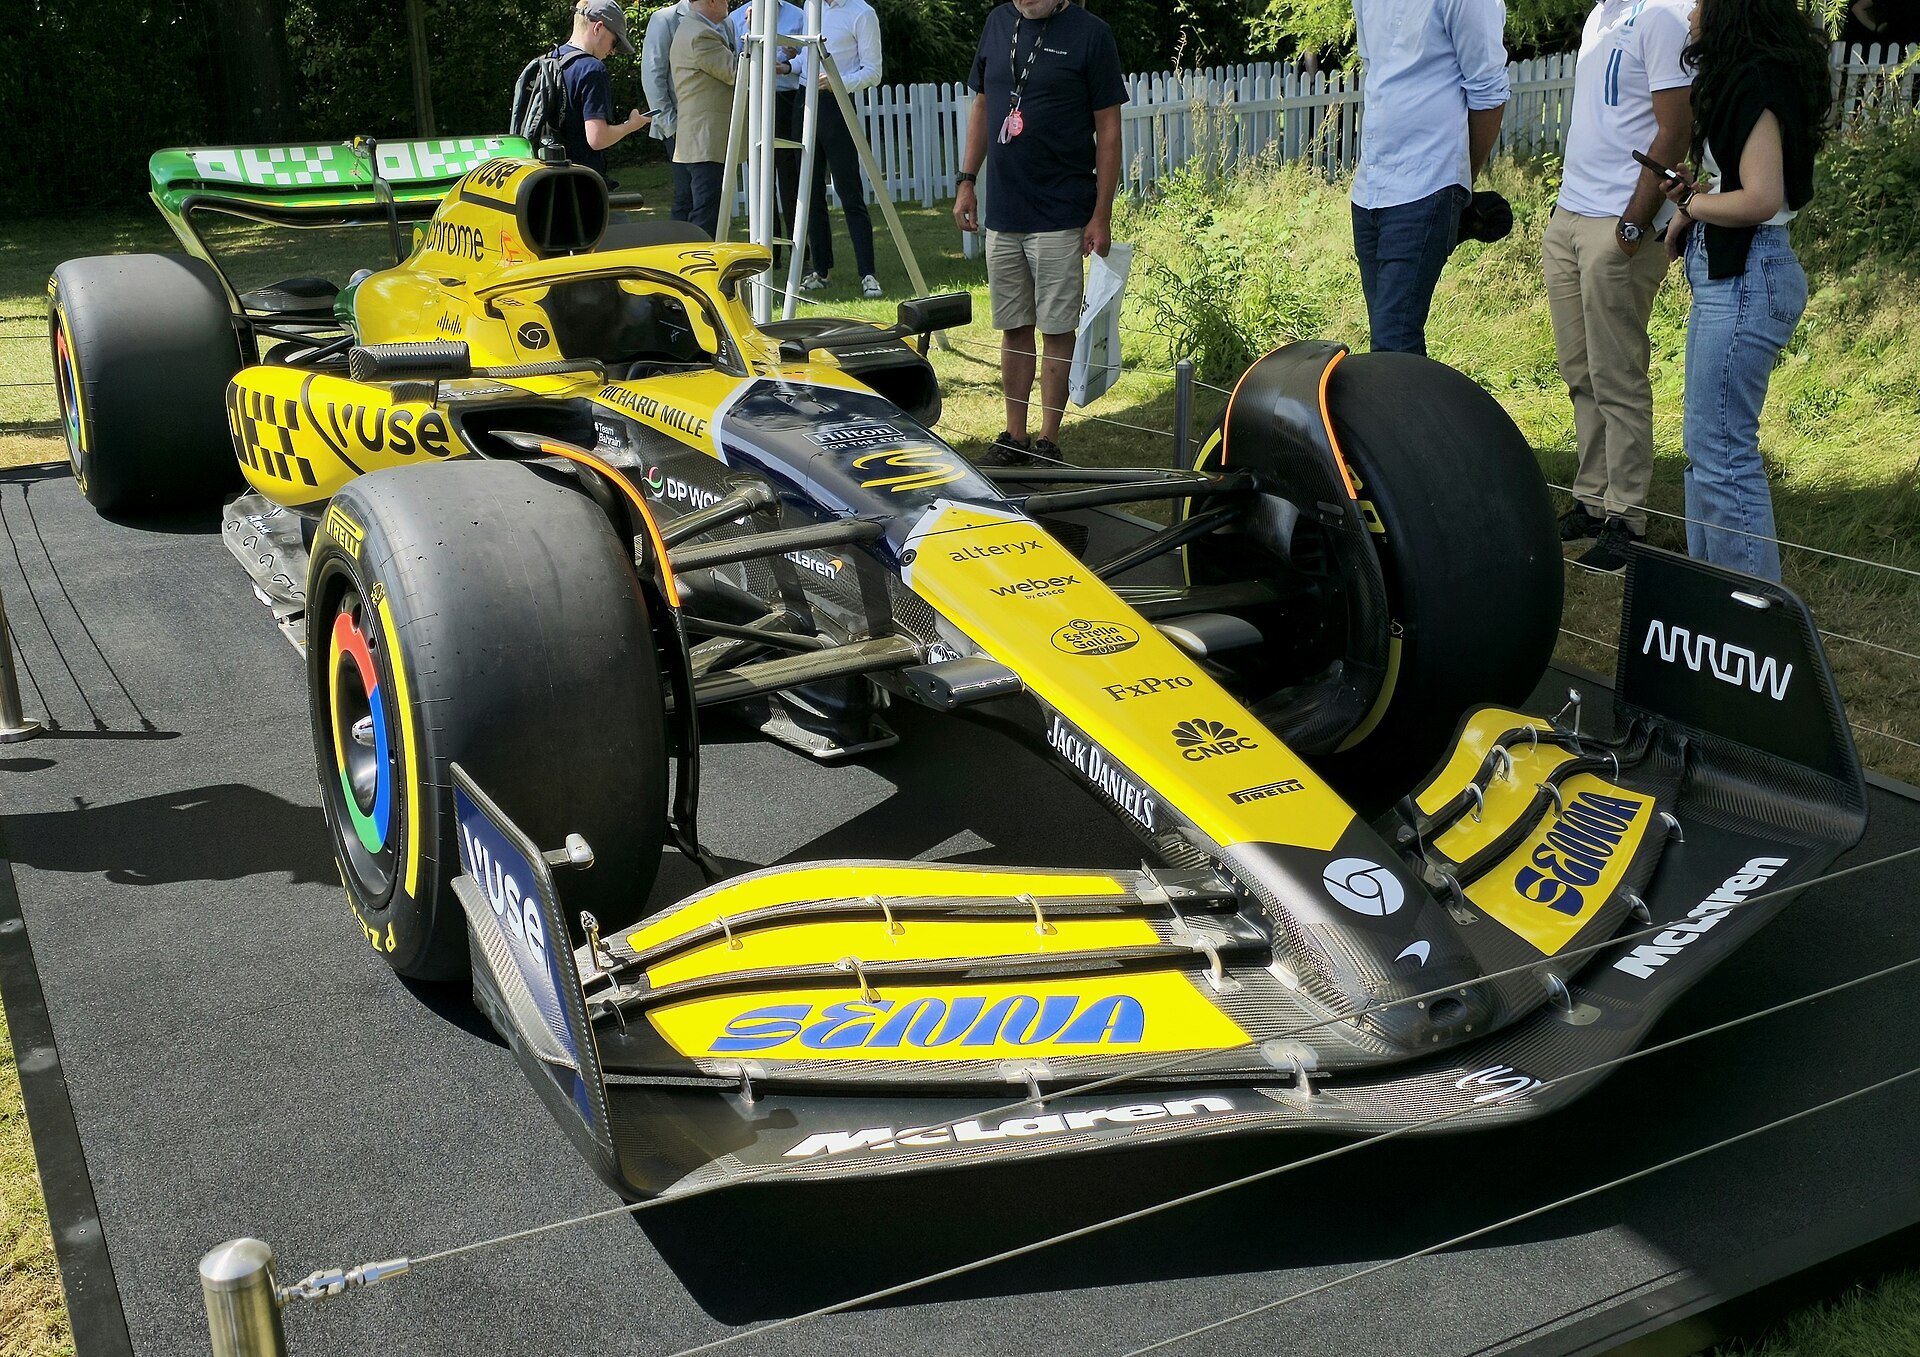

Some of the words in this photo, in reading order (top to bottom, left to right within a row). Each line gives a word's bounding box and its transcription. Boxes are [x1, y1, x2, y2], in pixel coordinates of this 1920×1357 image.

[426, 207, 484, 262] chrome
[598, 385, 659, 419] RICHARD
[660, 405, 707, 439] MILLE
[599, 422, 614, 436] Team
[599, 432, 621, 448] Bahrain
[813, 426, 894, 444] Hilton
[822, 441, 847, 451] FOR
[849, 438, 876, 448] THE
[879, 434, 908, 444] STAY
[667, 478, 687, 501] DP
[325, 504, 364, 560] PIRELLI
[949, 540, 1043, 562] alteryx
[784, 550, 836, 580] cLaren
[990, 575, 1082, 597] webex
[1063, 626, 1120, 642] Estrella
[1072, 634, 1126, 649] Galicia
[1642, 619, 1793, 701] ARROW
[1102, 675, 1193, 702] FxPro
[1047, 715, 1087, 774] JACK
[1182, 737, 1259, 762] CNBC
[1227, 778, 1306, 805] PIRELLI
[1514, 791, 1643, 917] SENNA
[1613, 856, 1790, 980] McLaren
[707, 994, 1145, 1051] SENNA
[781, 1097, 1235, 1157] McLaren
